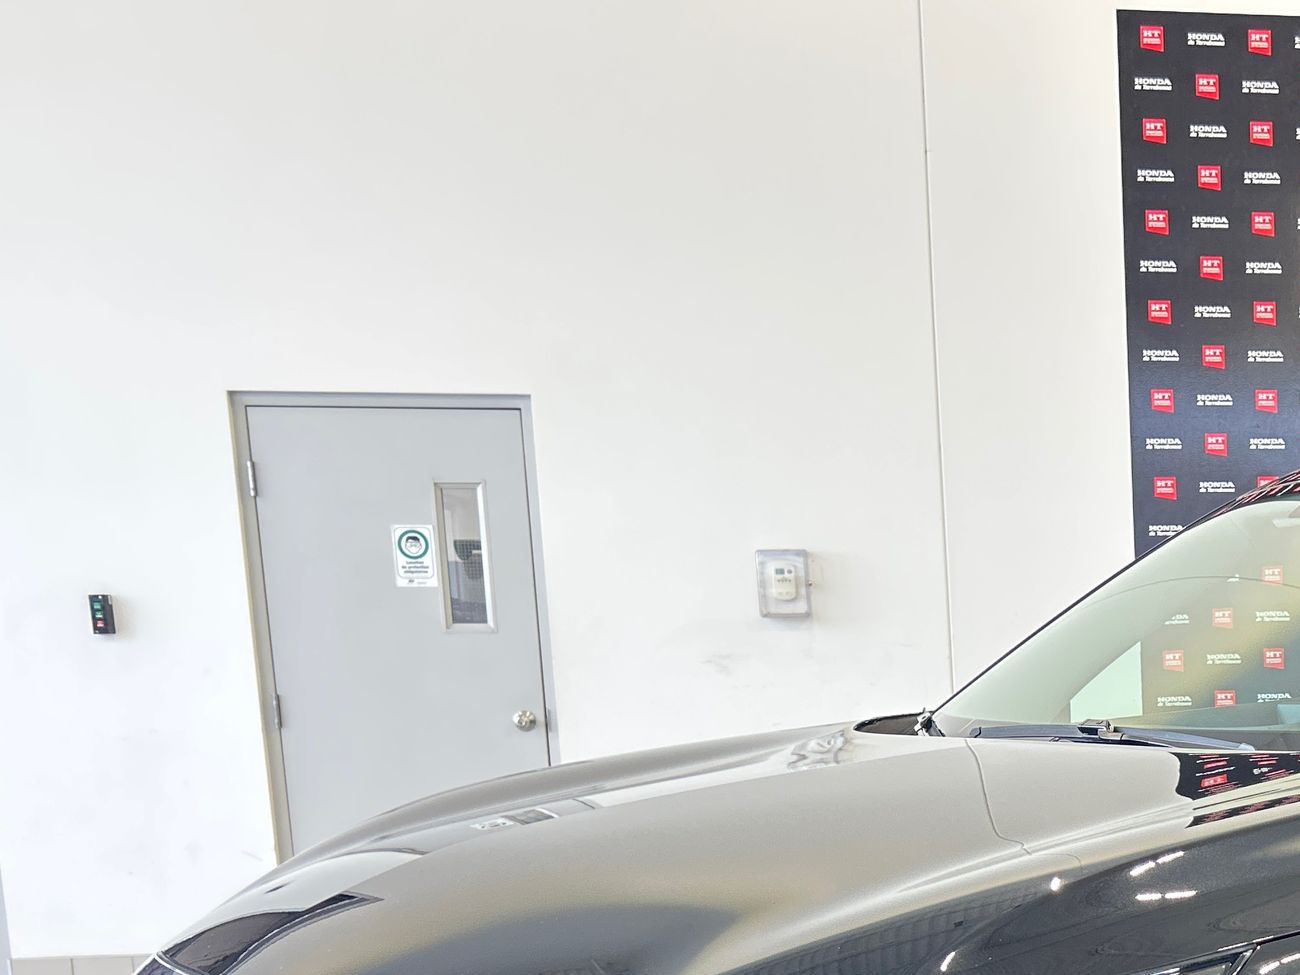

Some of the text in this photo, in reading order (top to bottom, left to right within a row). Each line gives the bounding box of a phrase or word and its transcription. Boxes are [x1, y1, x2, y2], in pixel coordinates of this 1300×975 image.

[1187, 33, 1225, 41] HONDA
[1242, 80, 1279, 89] HONDA
[1189, 125, 1227, 133] HONDA
[1137, 169, 1174, 177] HONDA
[1244, 171, 1280, 179] HONDA
[1192, 216, 1228, 224] HONDA
[1139, 260, 1176, 268] HONDA
[1142, 349, 1179, 357] HONDA
[1247, 350, 1283, 358] HONDA
